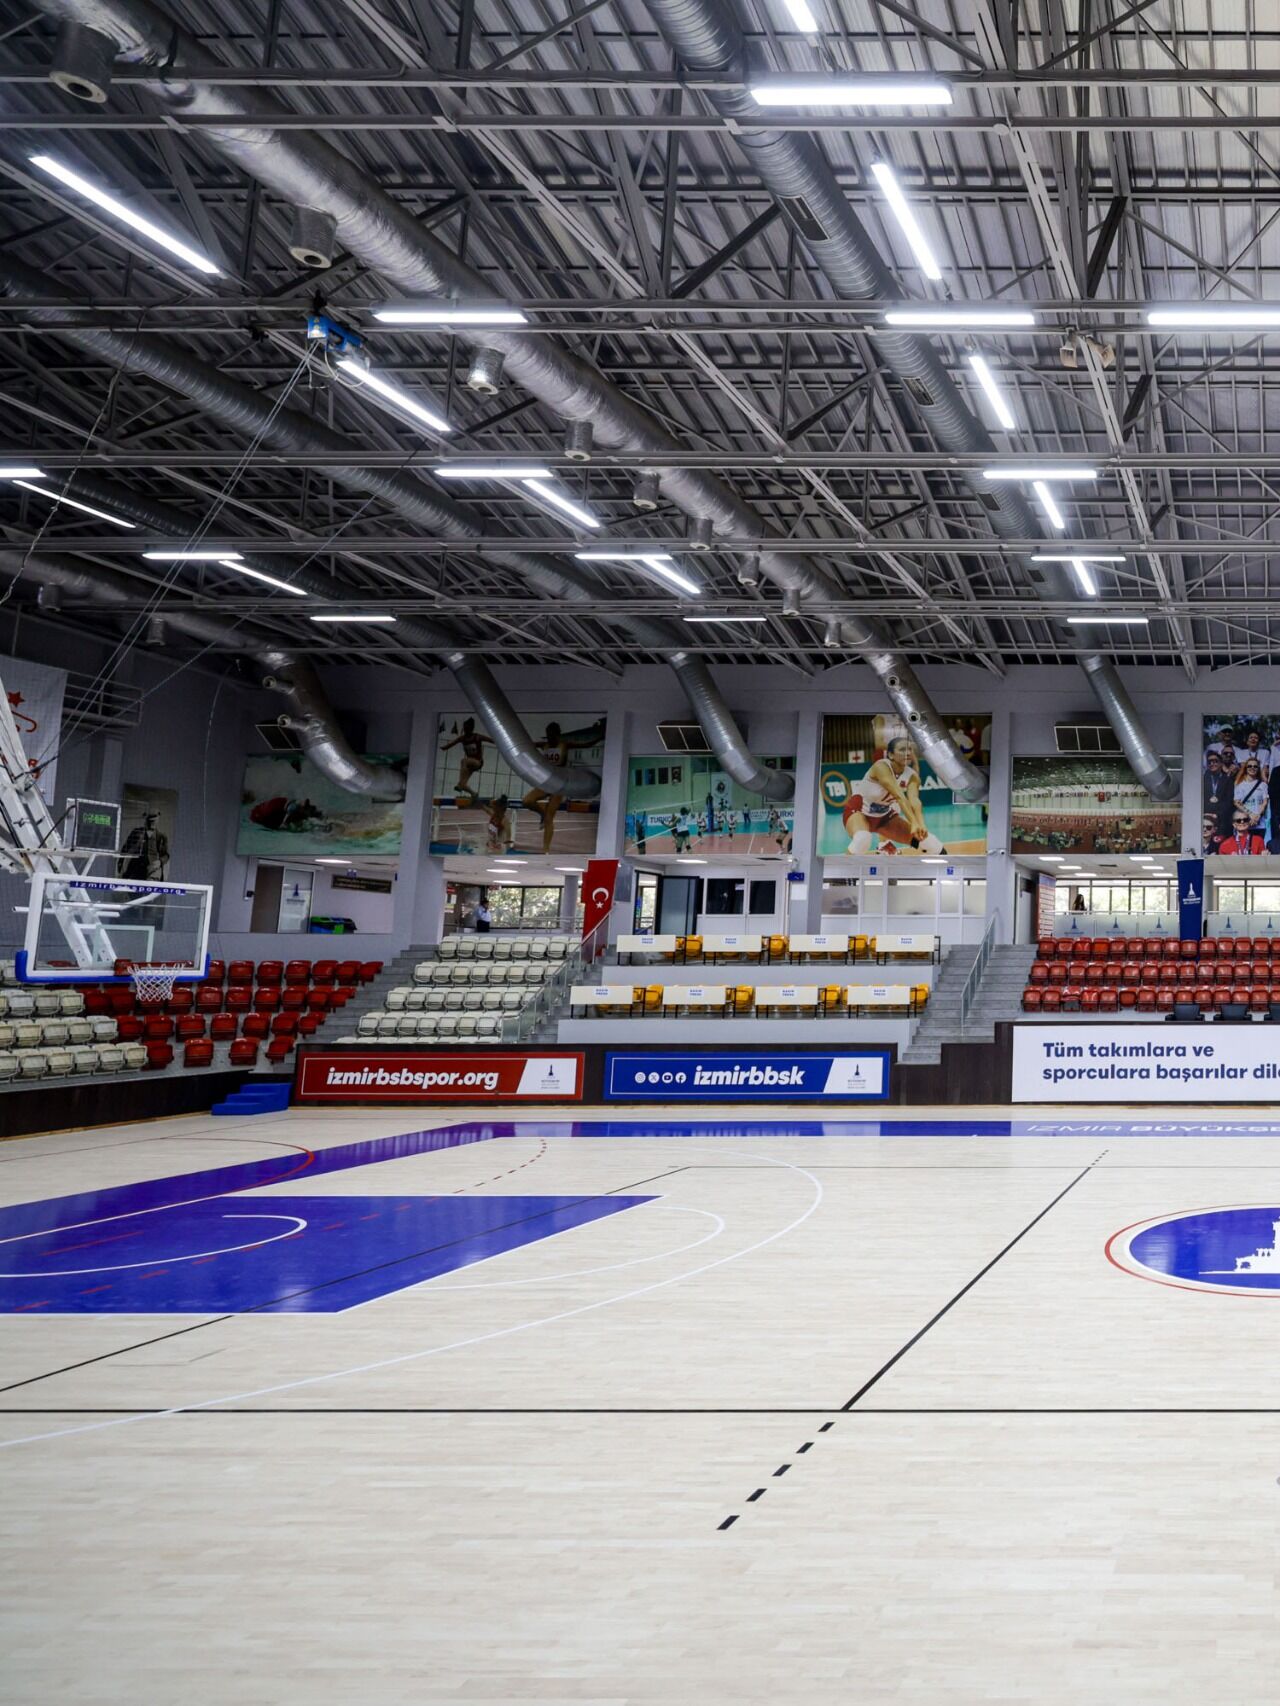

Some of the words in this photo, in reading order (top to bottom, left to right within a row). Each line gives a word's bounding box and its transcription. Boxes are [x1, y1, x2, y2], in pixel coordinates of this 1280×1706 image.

[1043, 1042, 1083, 1057] Tüm
[1088, 1042, 1187, 1058] takımlara
[1192, 1044, 1214, 1057] ve
[326, 1067, 499, 1090] izmirbsbspor.org
[693, 1065, 806, 1086] izmirbbsk
[1043, 1064, 1150, 1083] sporculara
[1156, 1064, 1247, 1083] başarılar
